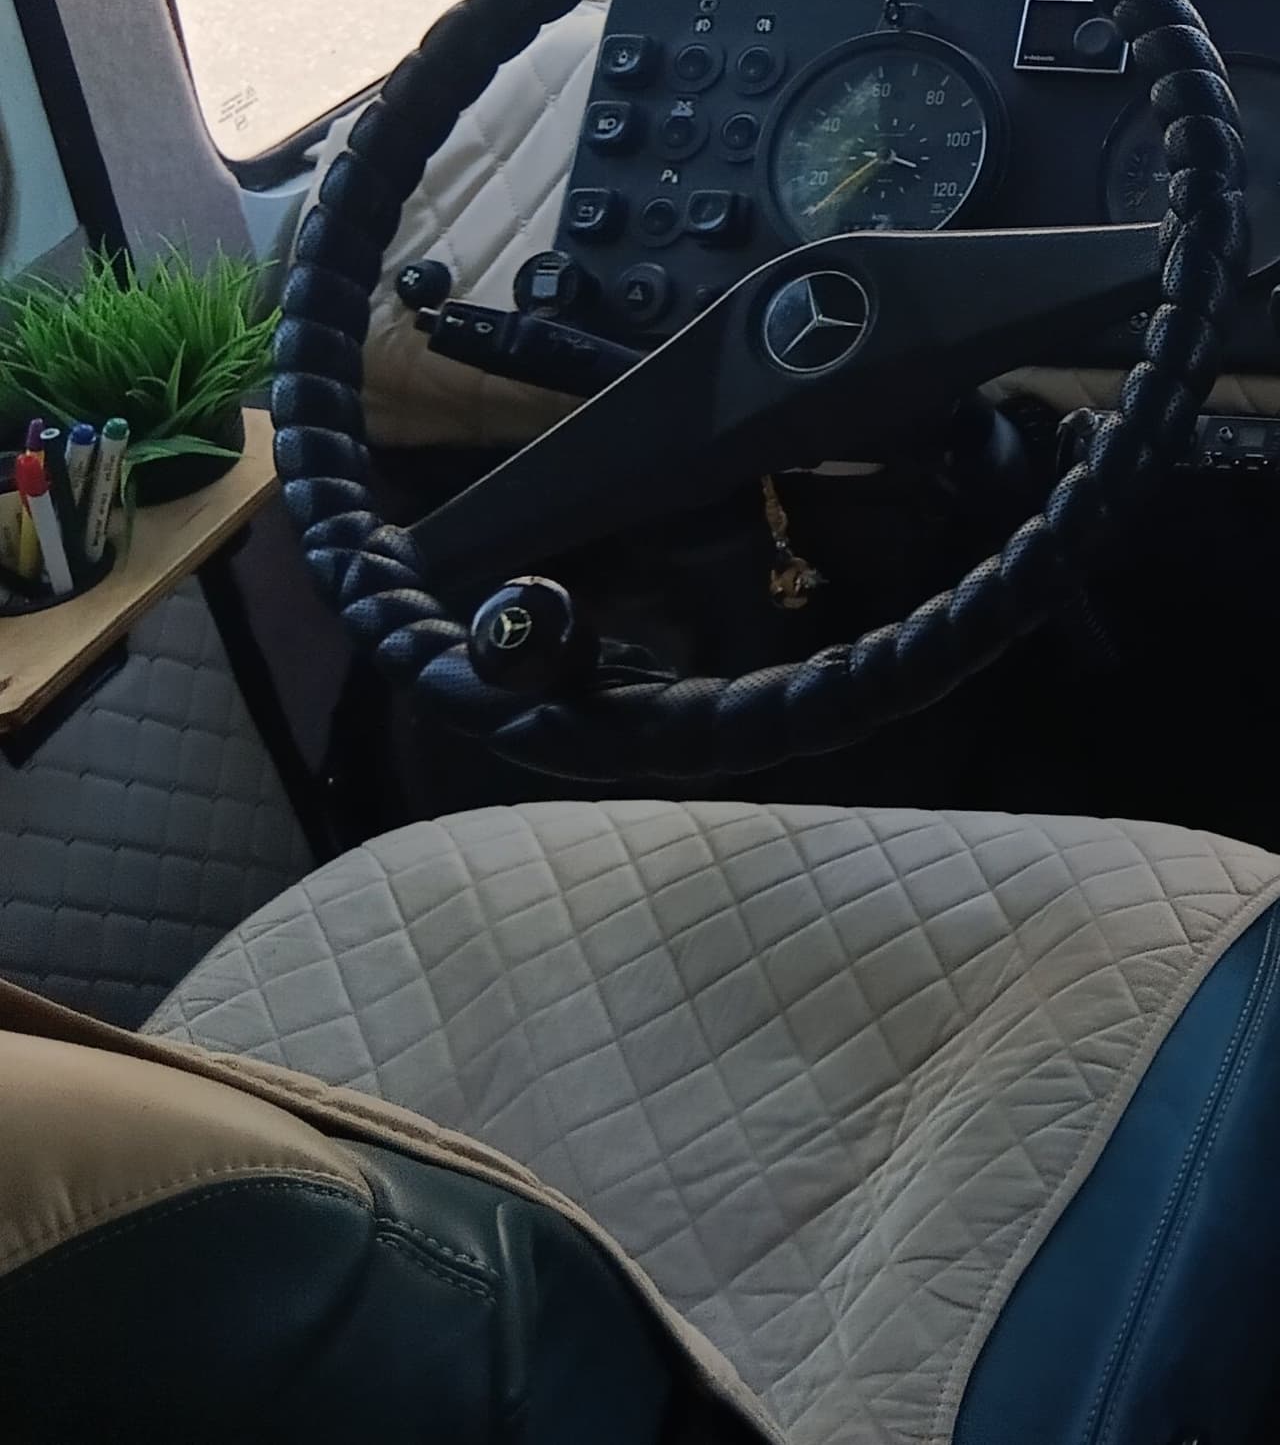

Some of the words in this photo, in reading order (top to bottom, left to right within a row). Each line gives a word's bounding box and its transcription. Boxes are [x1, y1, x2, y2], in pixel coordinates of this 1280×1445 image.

[872, 83, 891, 97] 60
[925, 90, 945, 106] 80
[822, 117, 841, 132] 40
[946, 132, 971, 147] 100
[809, 170, 829, 186] 20
[933, 182, 957, 197] 120
